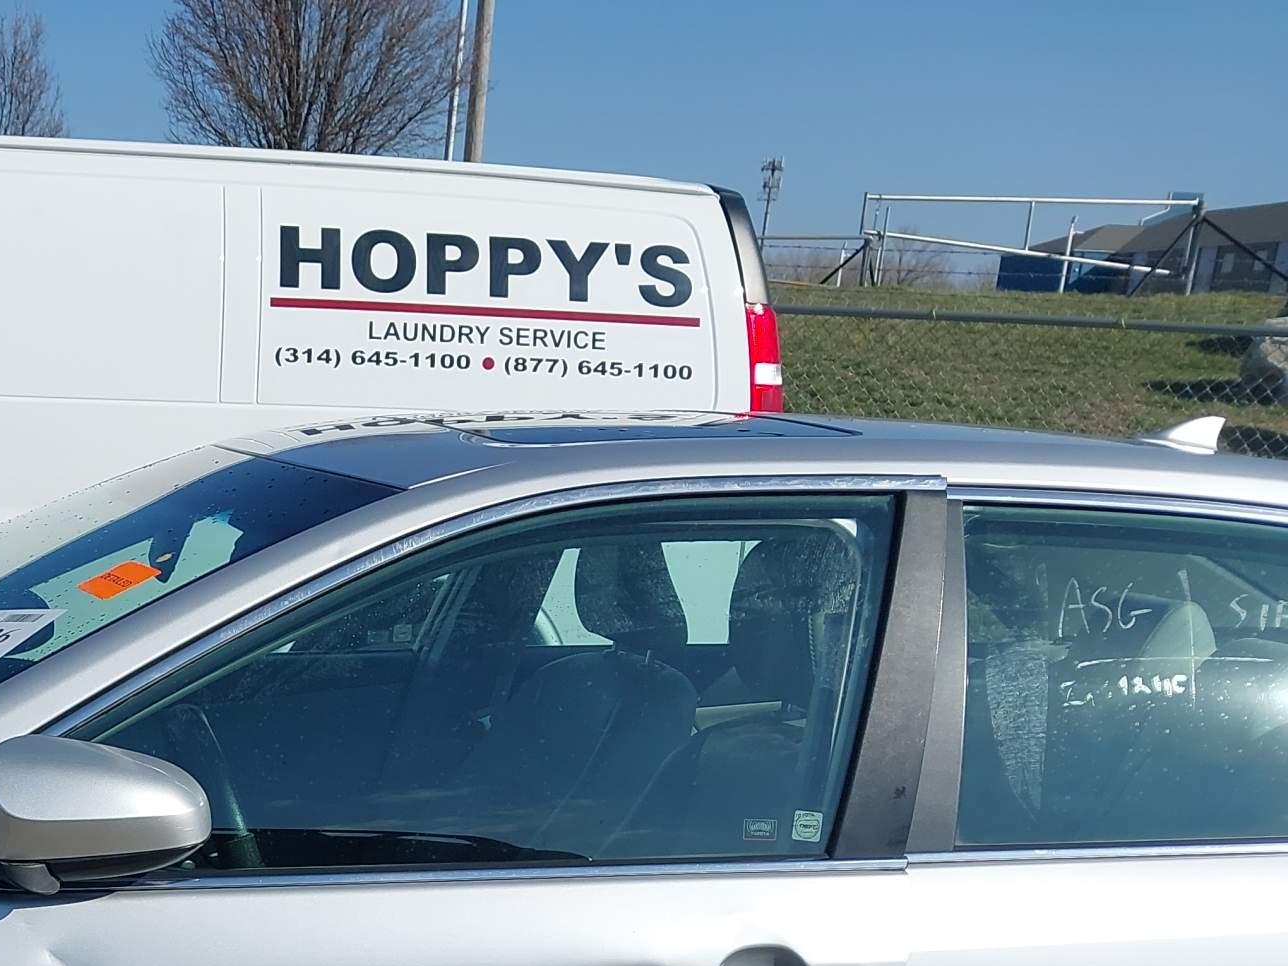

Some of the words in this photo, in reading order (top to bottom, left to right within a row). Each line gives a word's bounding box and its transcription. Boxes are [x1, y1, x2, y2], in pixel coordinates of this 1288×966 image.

[279, 225, 693, 308] HOPPY'S
[368, 321, 491, 346] LAUNDRY
[499, 326, 607, 350] SERVICE
[274, 347, 342, 369] (314)
[350, 350, 472, 371] 645-1100
[504, 355, 569, 378] (877)
[577, 360, 694, 382] 645-1100
